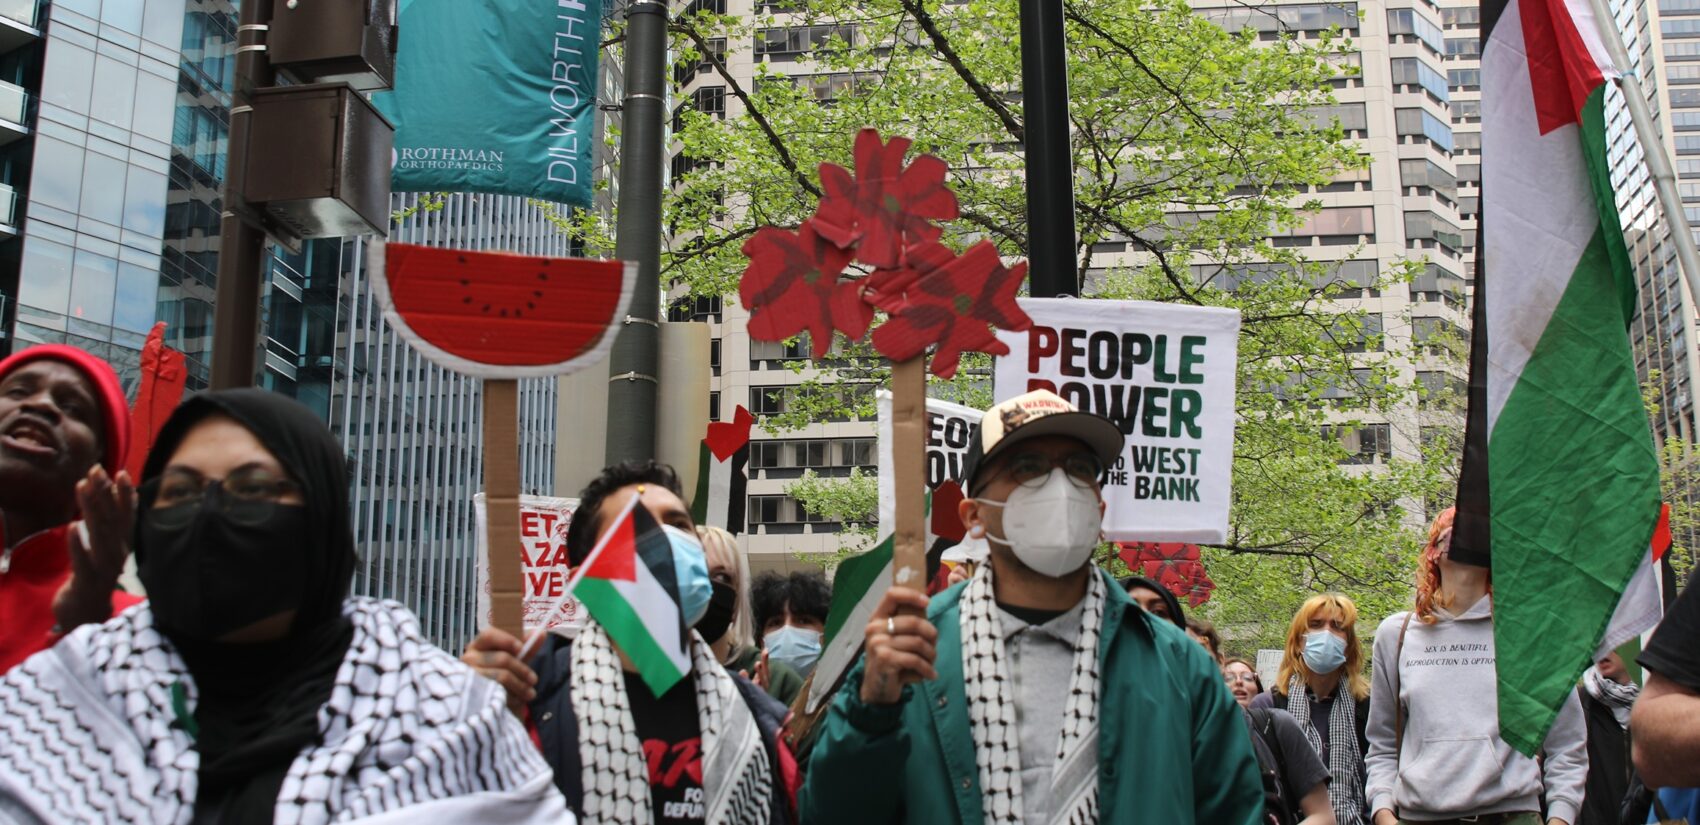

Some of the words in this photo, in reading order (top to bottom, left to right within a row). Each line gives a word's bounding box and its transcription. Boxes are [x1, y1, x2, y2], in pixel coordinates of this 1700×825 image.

[547, 15, 585, 185] DILWORTH
[400, 160, 504, 171] ORTHOPAEDICS
[401, 147, 504, 162] ROTHMAN
[1028, 325, 1207, 384] PEOPLE
[1027, 379, 1202, 439] OWER
[1131, 445, 1202, 476] WEST
[1134, 475, 1201, 502] BANK
[521, 512, 558, 538] ET
[1424, 645, 1437, 653] SEX
[1449, 643, 1489, 652] BEAUTIFUL
[1405, 658, 1458, 668] REPRODUCTION
